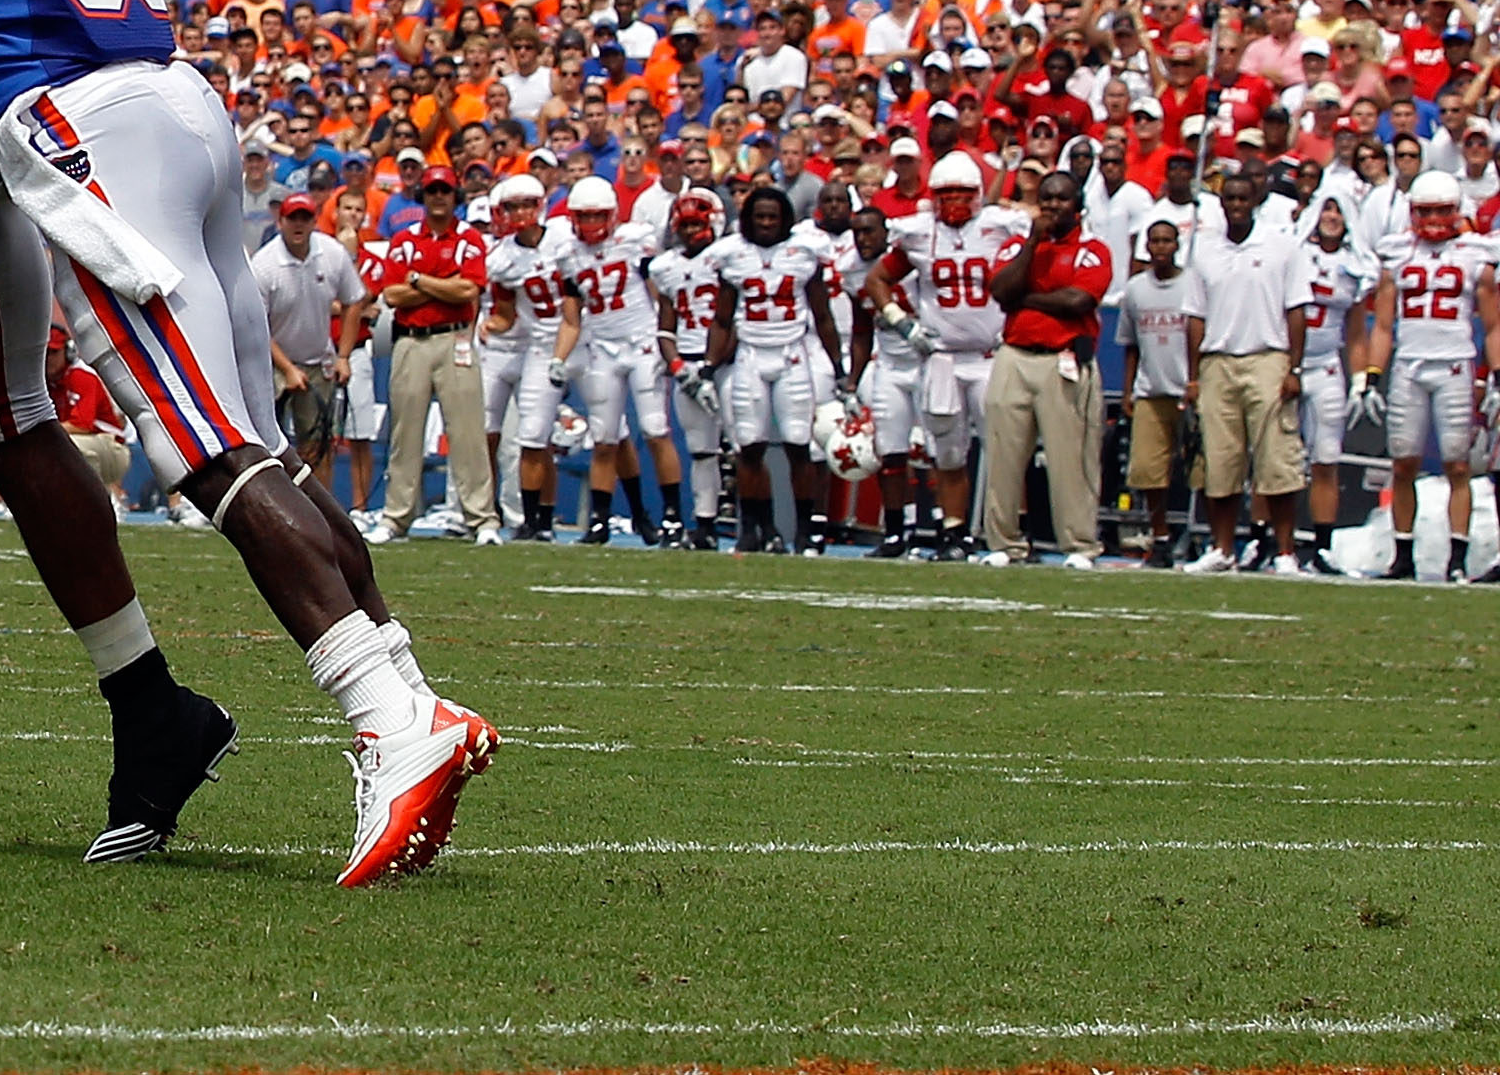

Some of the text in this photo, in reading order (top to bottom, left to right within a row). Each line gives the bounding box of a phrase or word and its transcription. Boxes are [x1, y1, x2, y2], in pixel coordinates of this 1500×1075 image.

[577, 260, 628, 315] 37
[742, 275, 796, 322] 24
[932, 257, 991, 308] 90
[1401, 265, 1464, 320] 22
